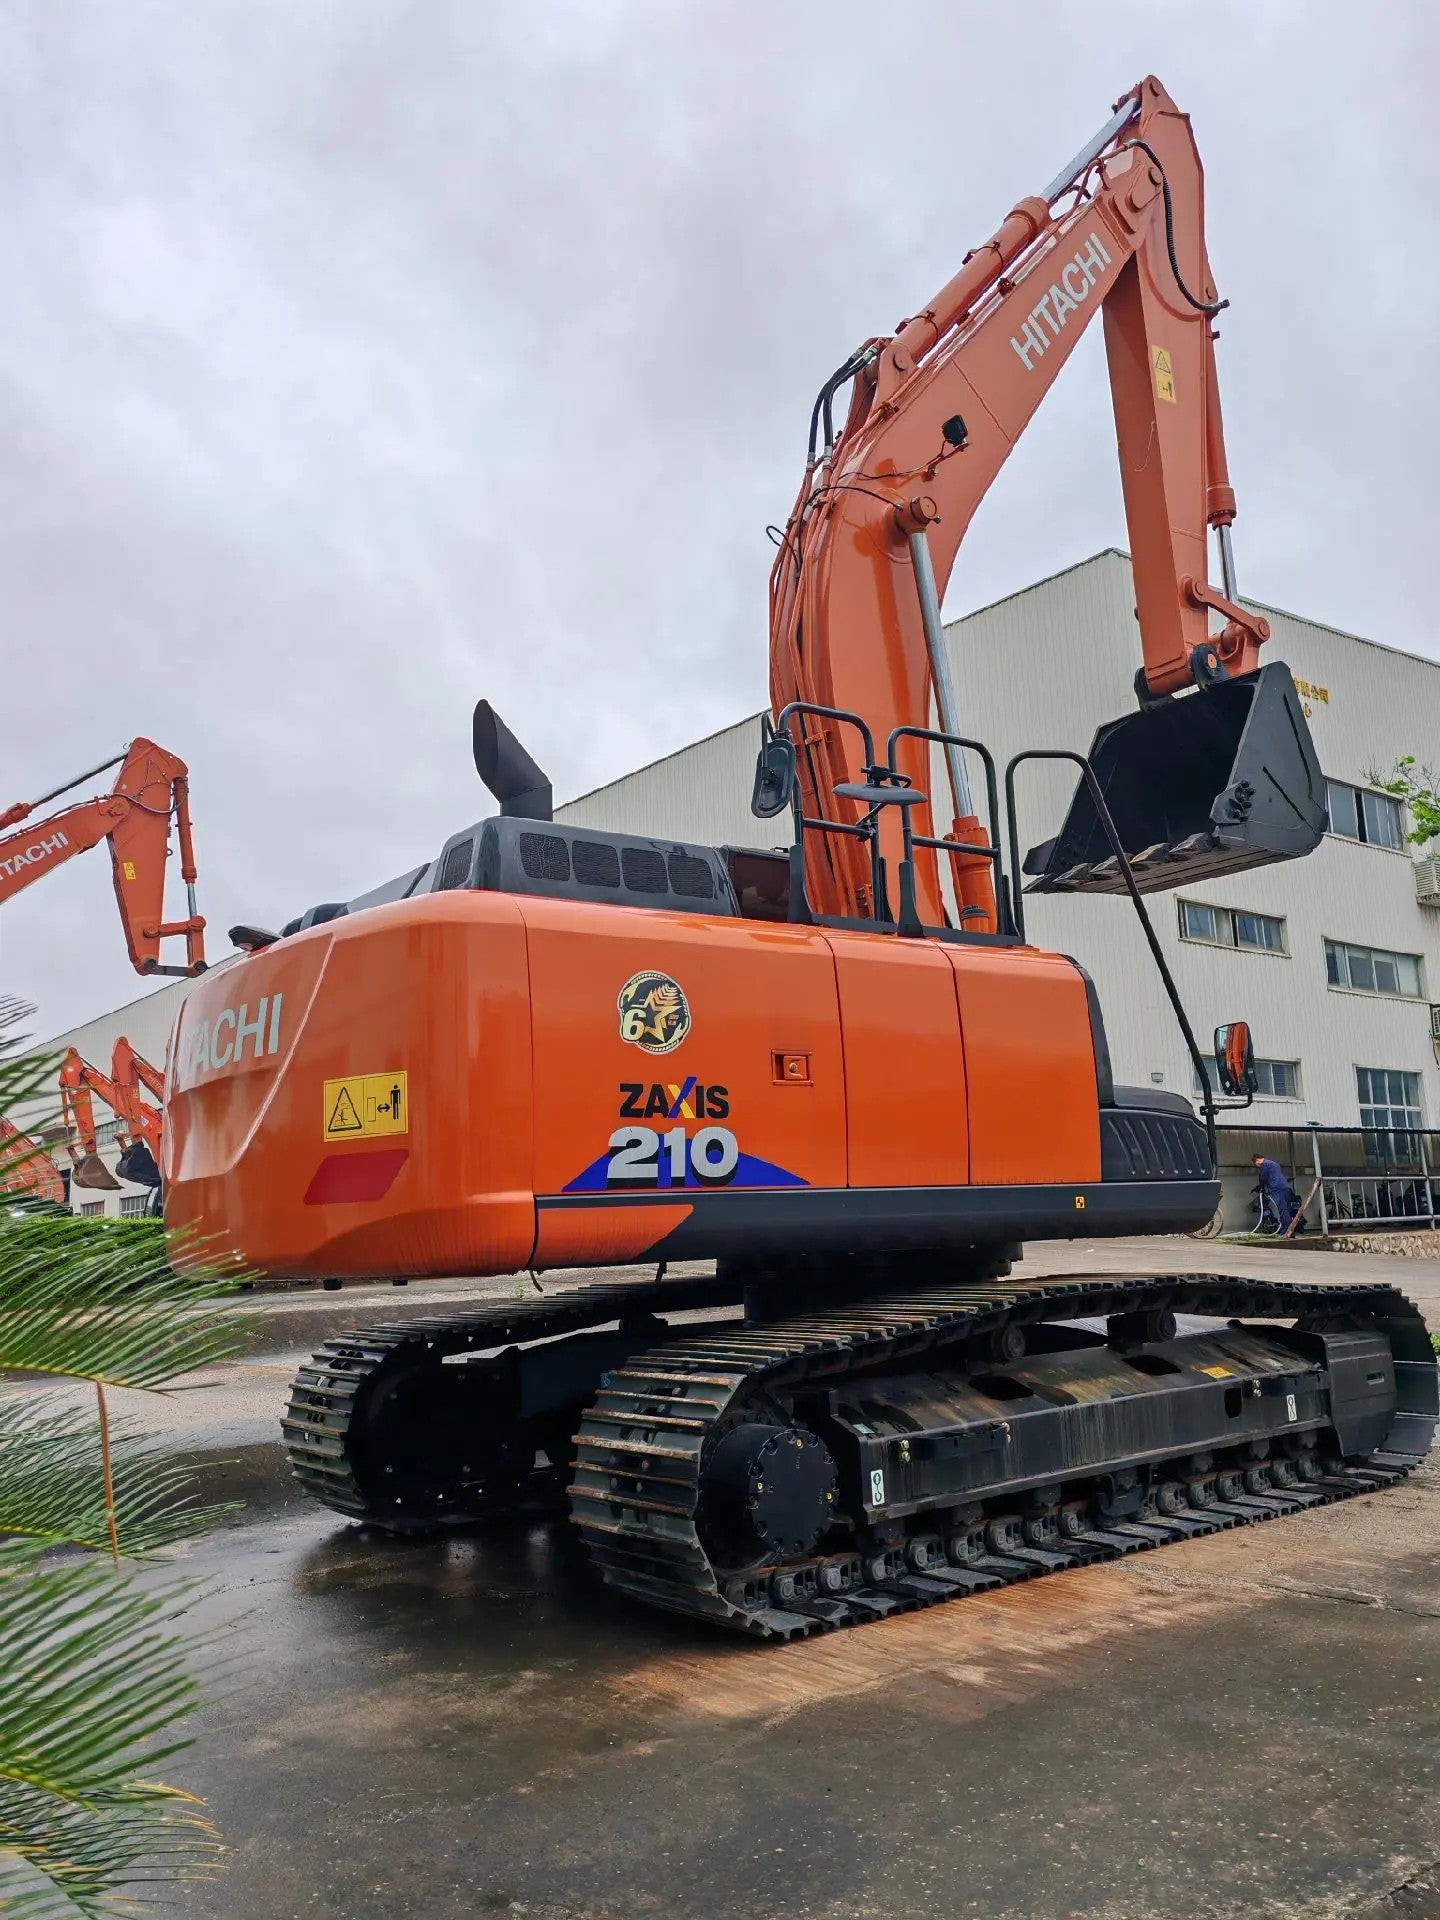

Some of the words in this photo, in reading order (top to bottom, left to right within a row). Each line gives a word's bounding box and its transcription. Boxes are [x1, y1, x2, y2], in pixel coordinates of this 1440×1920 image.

[1009, 232, 1112, 371] HITACHI
[619, 1076, 730, 1119] ZAXIS
[607, 1126, 738, 1184] 210
